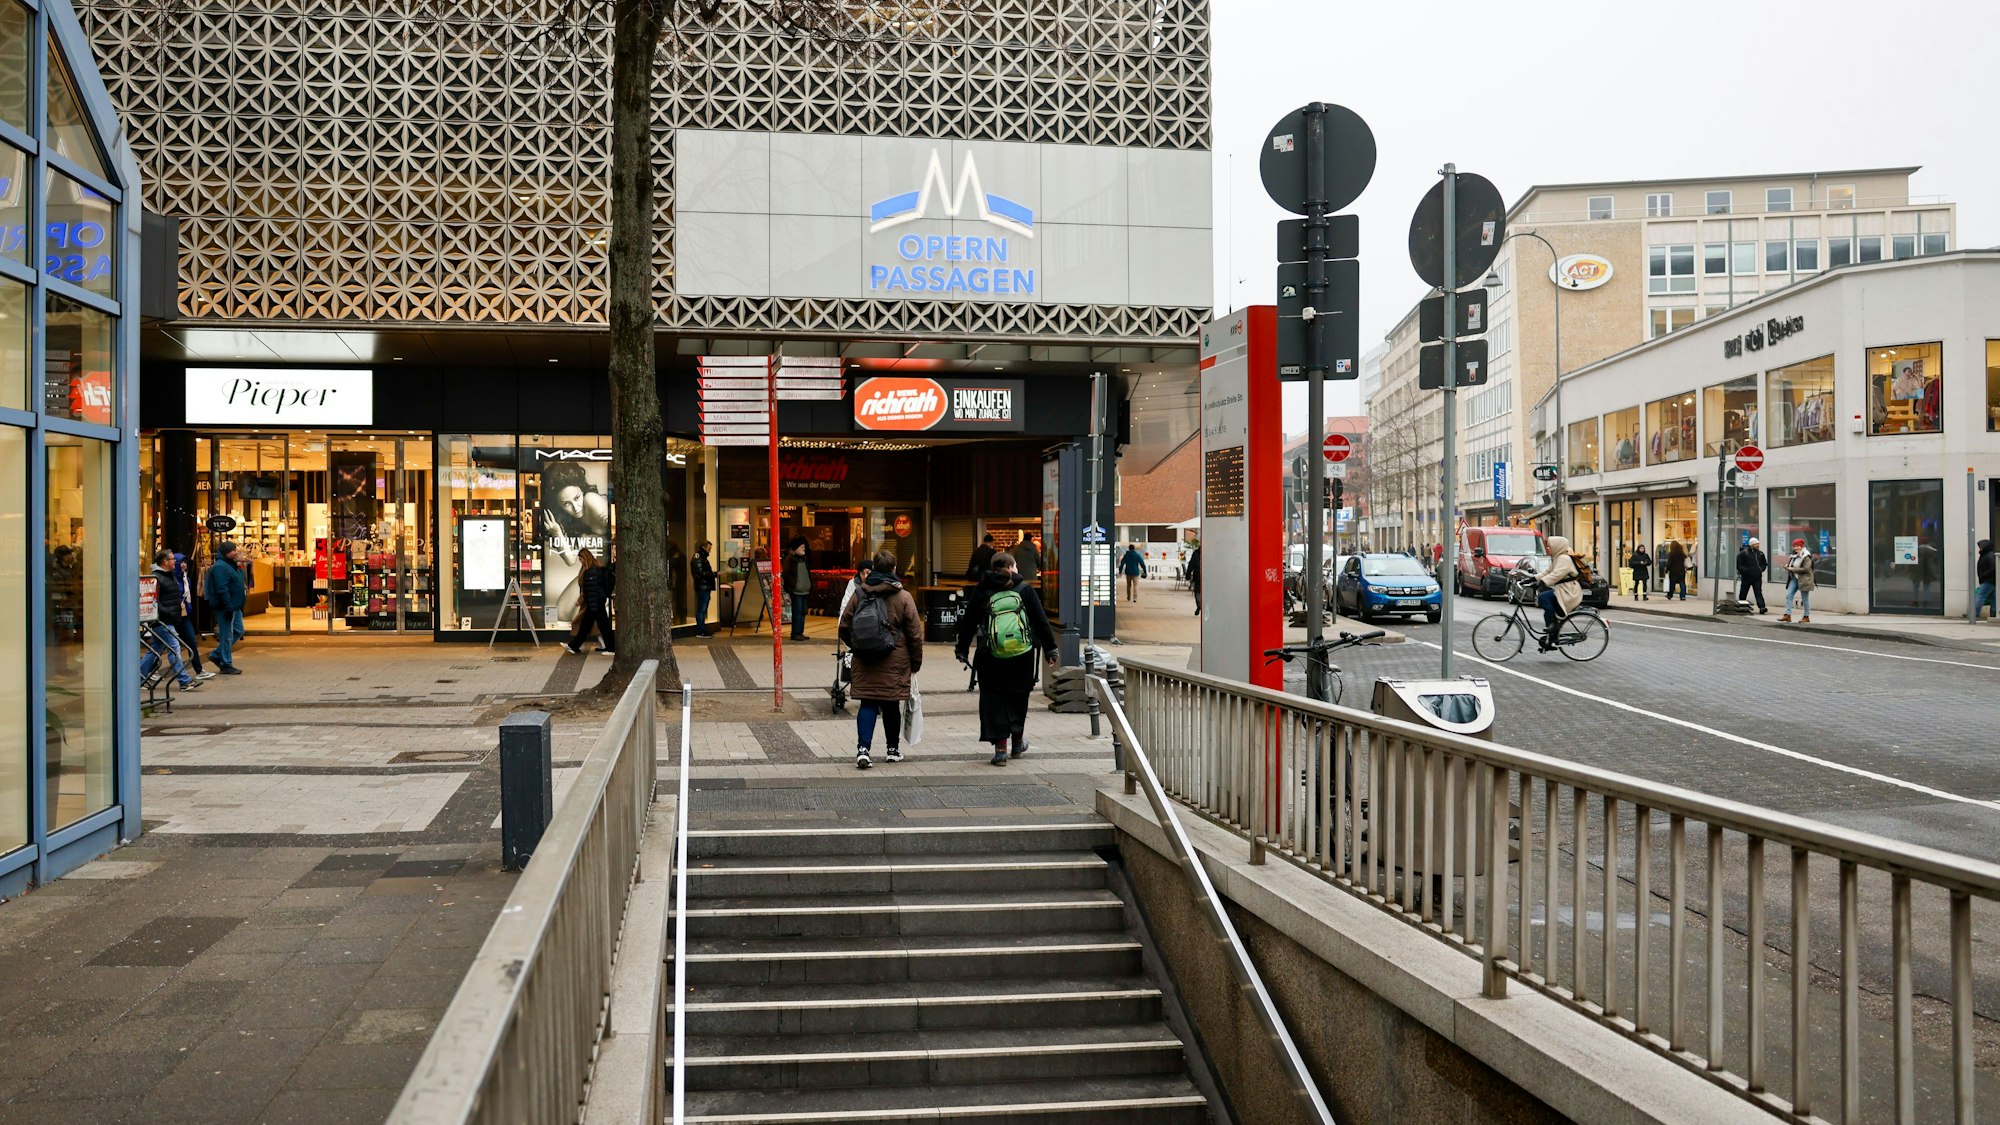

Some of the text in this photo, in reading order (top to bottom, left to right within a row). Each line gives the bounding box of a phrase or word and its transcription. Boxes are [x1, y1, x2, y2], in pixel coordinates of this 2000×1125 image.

[898, 234, 1008, 262] OPERN
[870, 264, 1035, 294] PASSAGEN
[222, 378, 337, 415] Pieper
[861, 388, 938, 416] richrath
[954, 390, 1012, 409] EINKAUFEN
[965, 408, 977, 419] MAN
[979, 408, 1001, 419] ZUHAUSE
[809, 481, 819, 489] der
[820, 482, 841, 490] Region
[1496, 468, 1505, 498] bioladen
[549, 537, 553, 548] I
[554, 537, 576, 548] ONLY
[577, 537, 603, 548] WEAR
